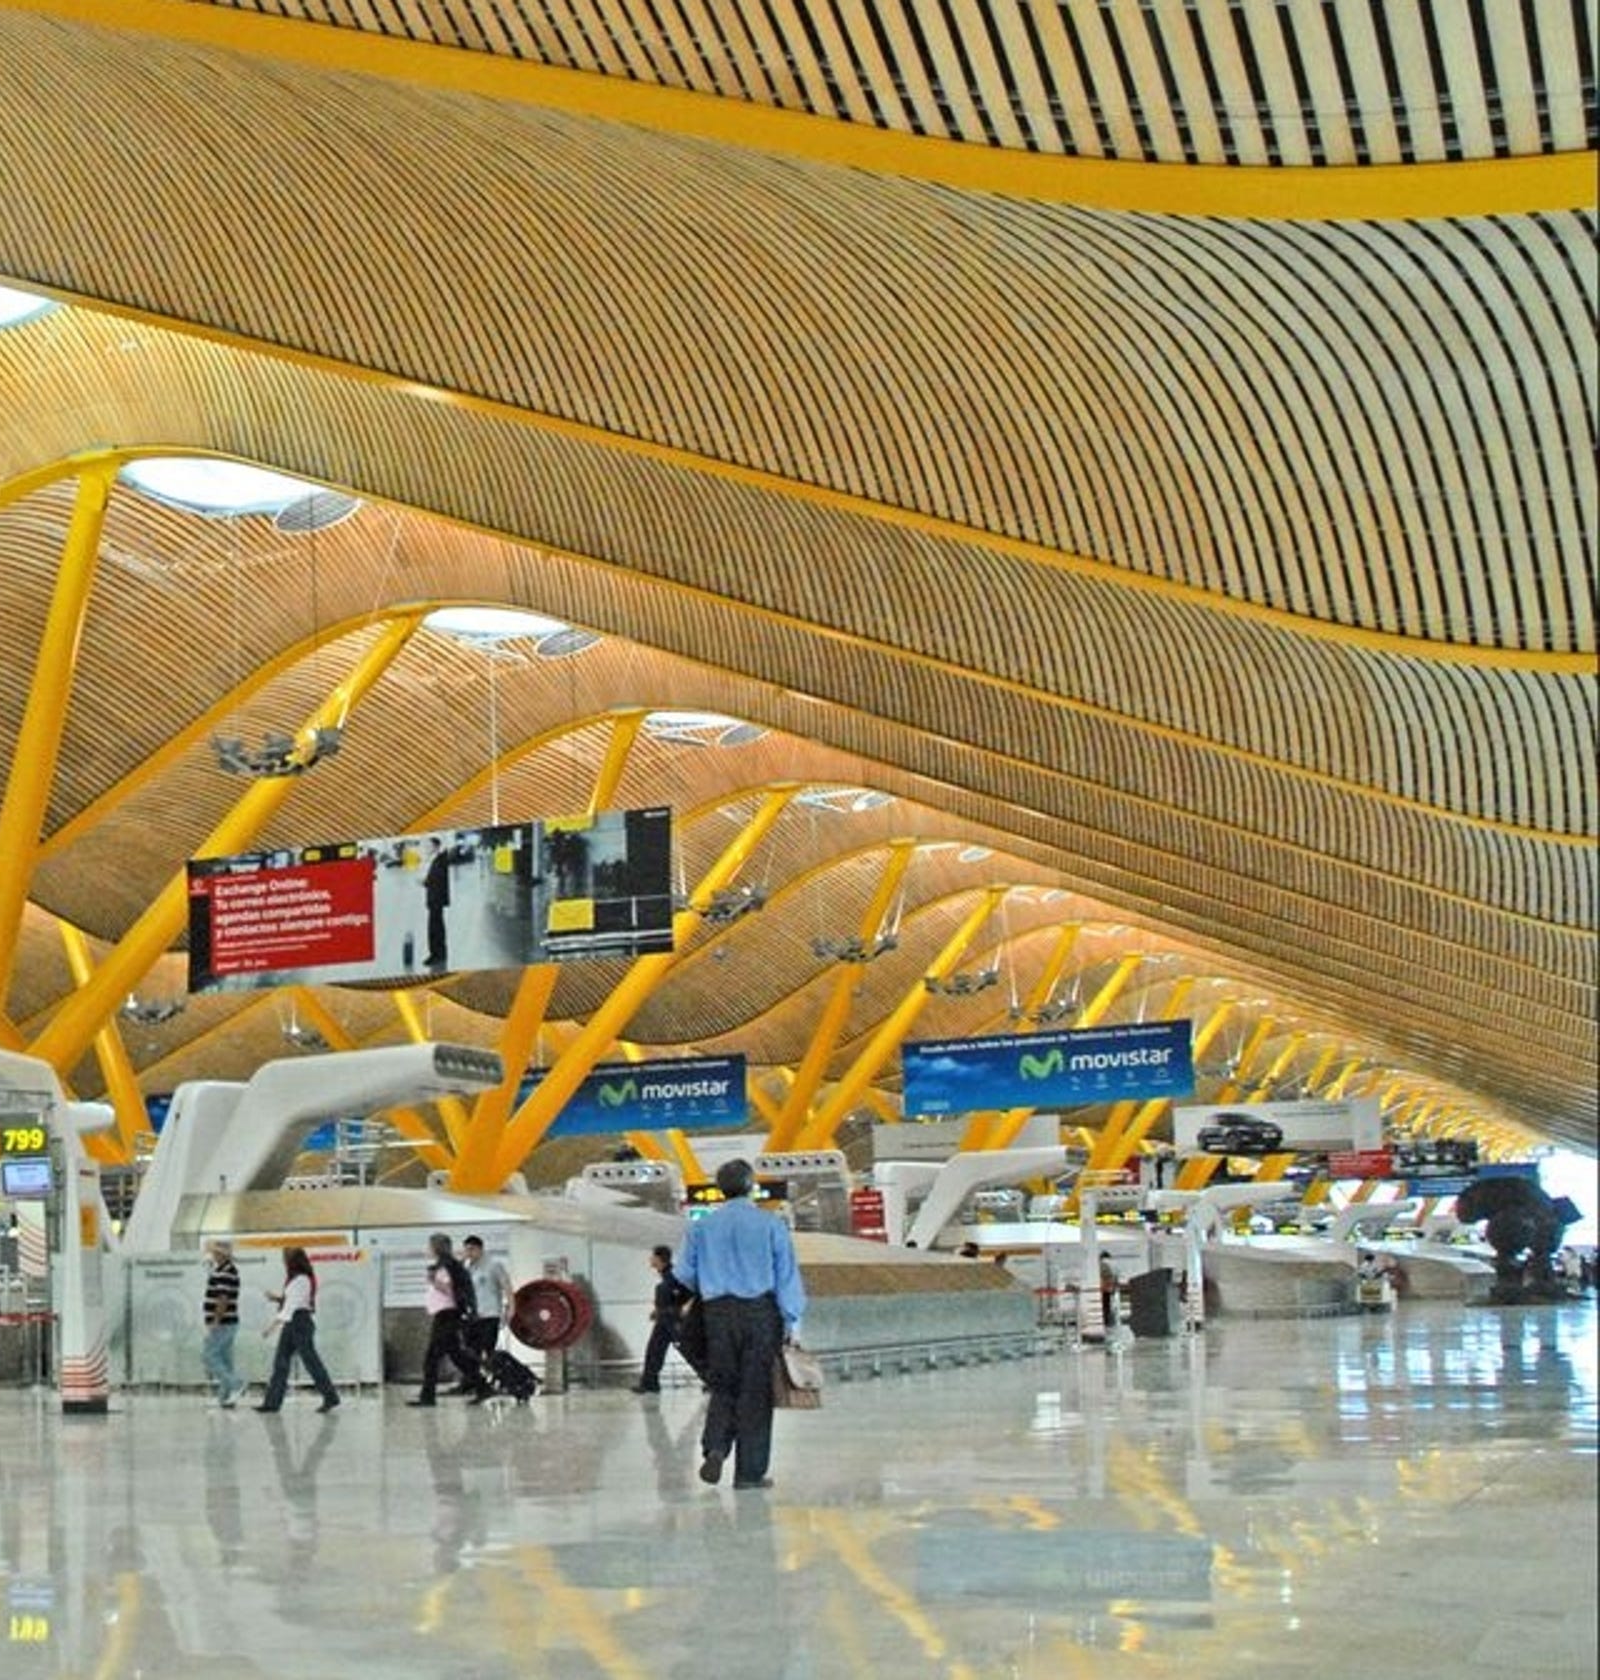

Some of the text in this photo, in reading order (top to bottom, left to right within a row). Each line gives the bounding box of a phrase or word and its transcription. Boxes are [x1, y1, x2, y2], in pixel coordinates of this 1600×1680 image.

[1070, 1046, 1174, 1072] movistar
[641, 1080, 730, 1100] movistar
[4, 1128, 44, 1151] 799
